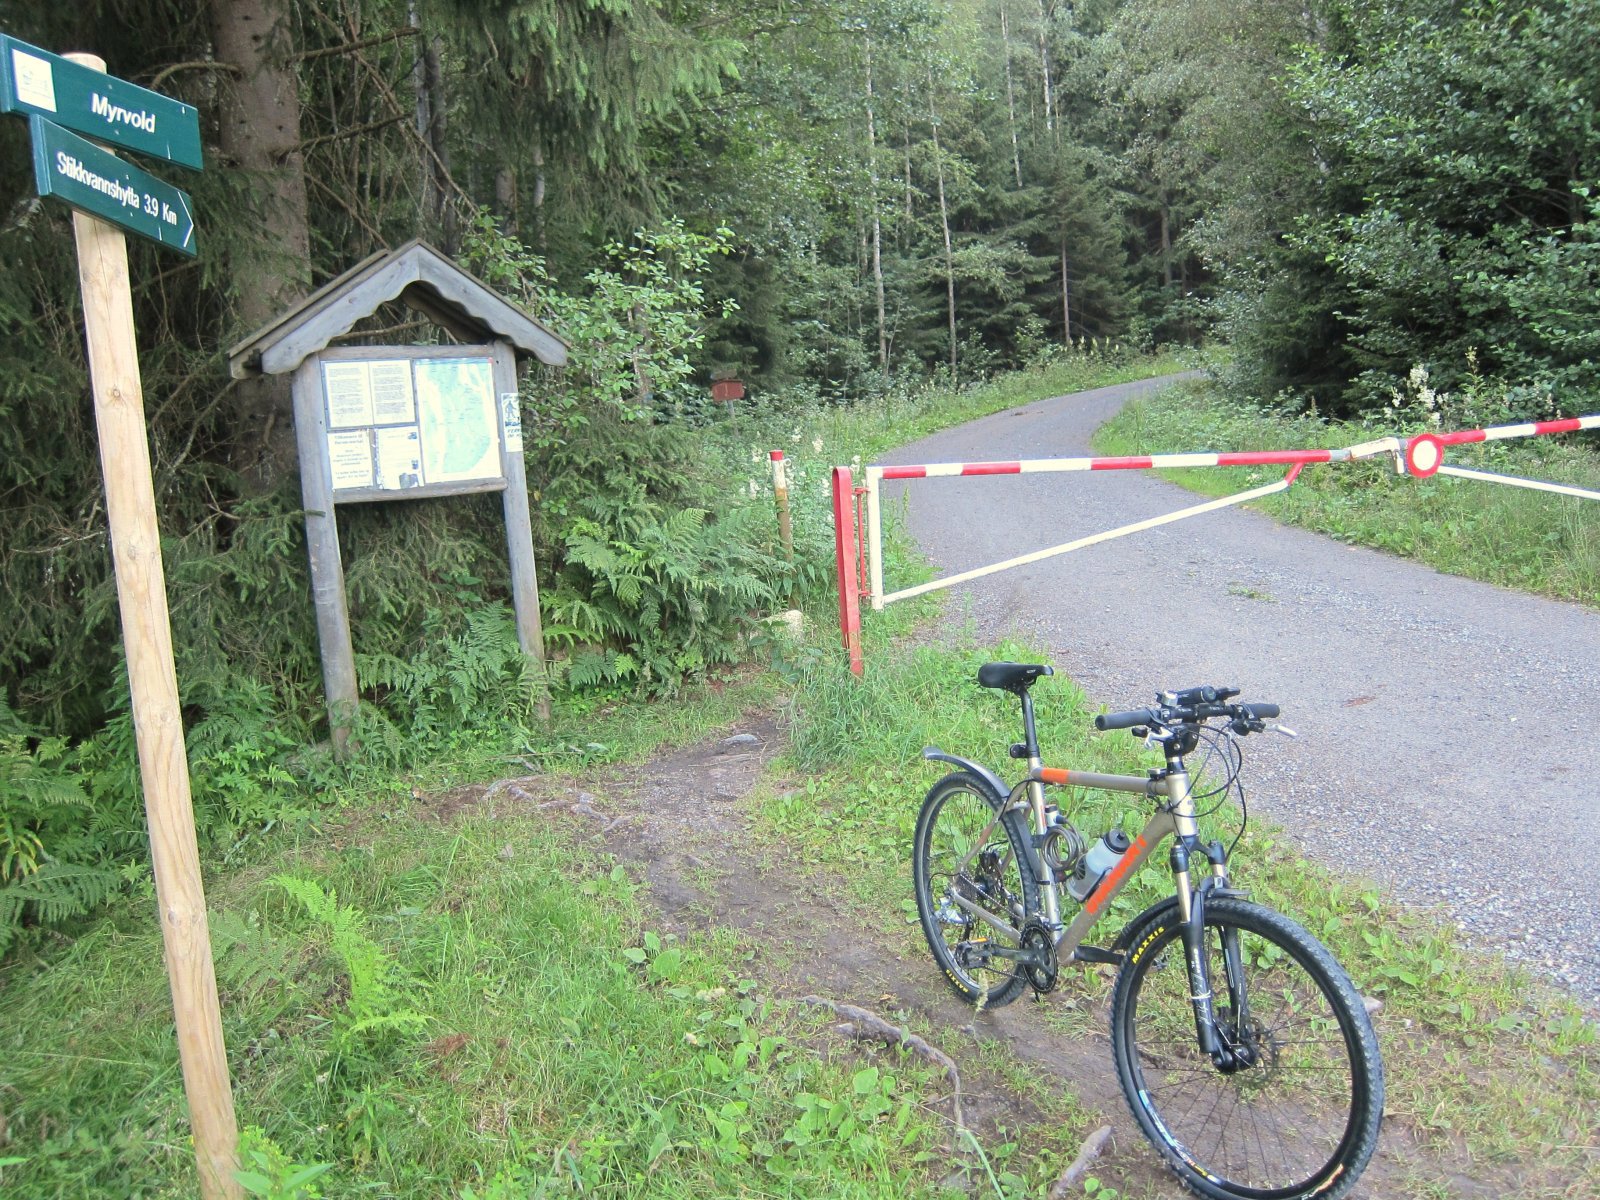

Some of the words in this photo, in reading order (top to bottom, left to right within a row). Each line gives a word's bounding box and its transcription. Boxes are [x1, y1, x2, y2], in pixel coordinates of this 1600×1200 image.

[92, 92, 156, 133] Myrvold
[57, 151, 140, 208] Stikkvannshytta
[162, 202, 177, 226] Km
[1132, 926, 1165, 964] MAXXIS
